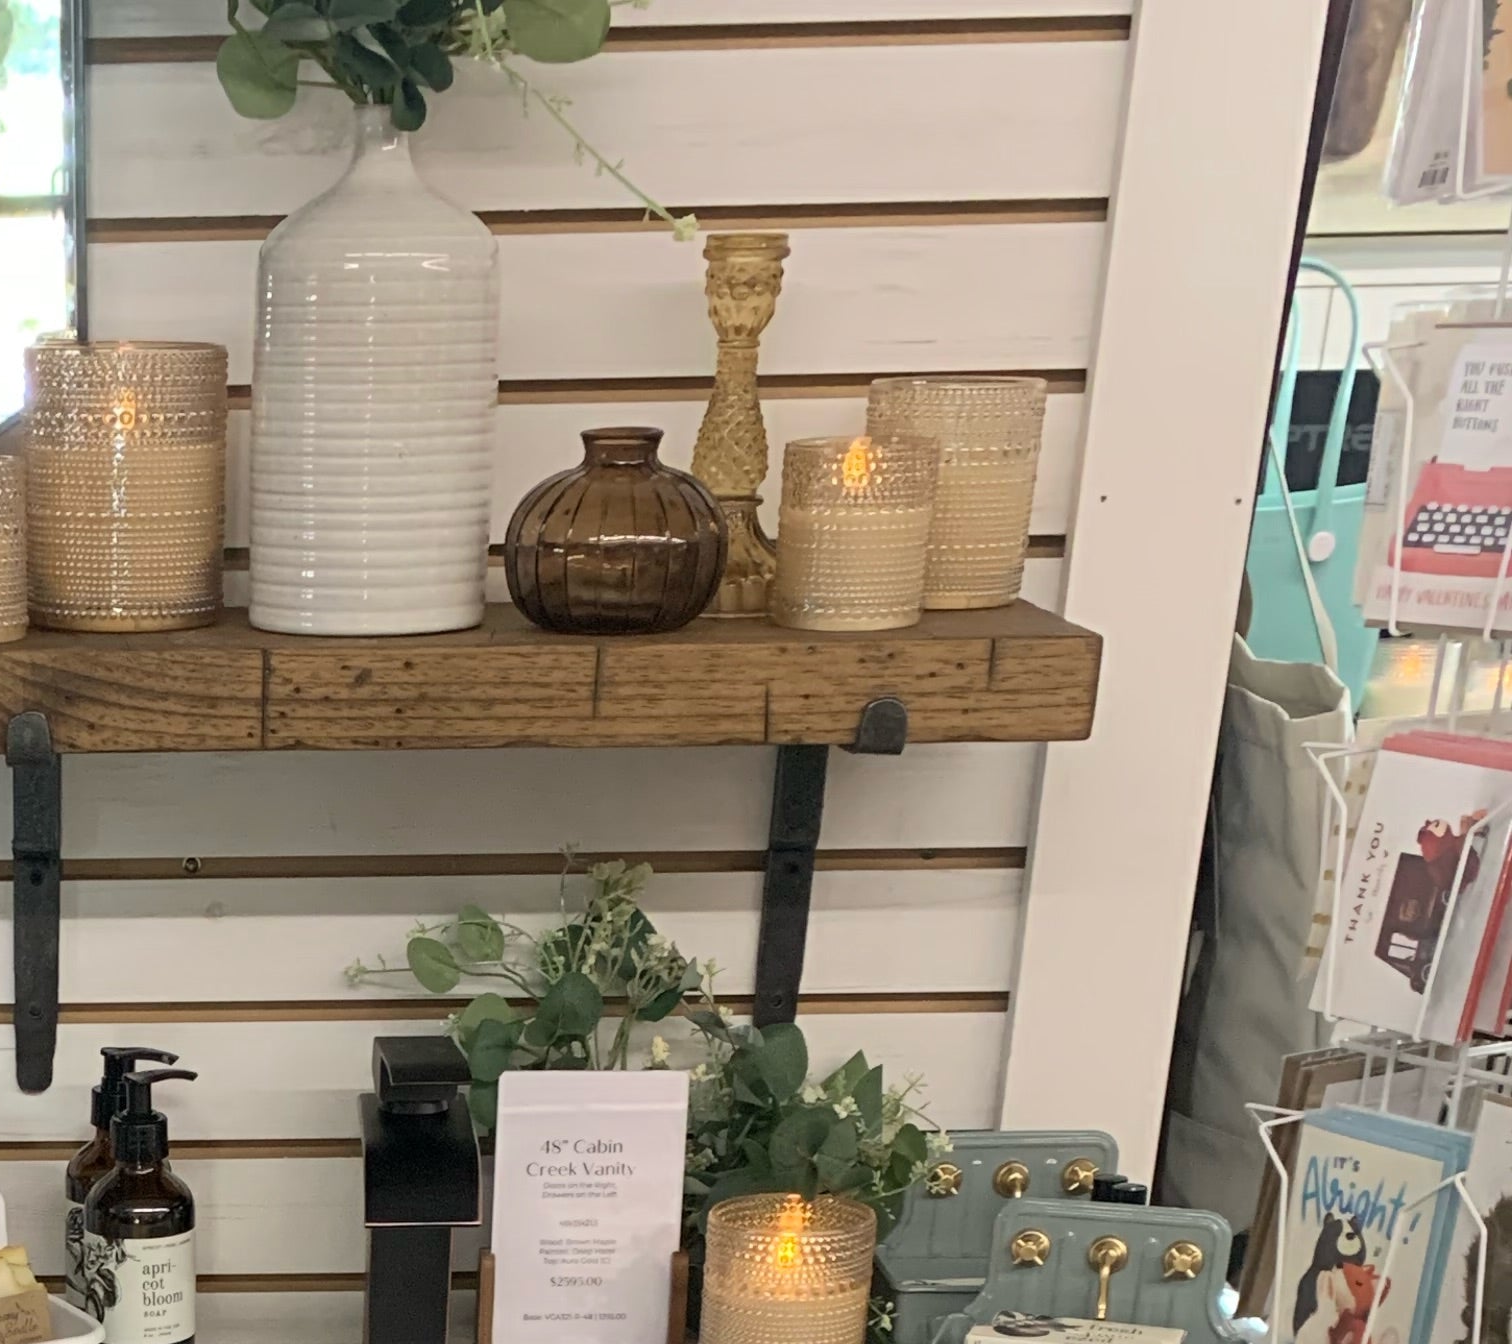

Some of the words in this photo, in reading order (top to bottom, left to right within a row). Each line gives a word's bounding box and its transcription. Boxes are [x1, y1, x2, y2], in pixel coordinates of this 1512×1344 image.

[1366, 822, 1385, 861] YOU
[1345, 873, 1370, 944] THANK
[573, 1139, 623, 1154] Cabin
[526, 1162, 577, 1177] Creek
[583, 1161, 636, 1178] Vanity
[142, 1258, 177, 1276] apri-
[142, 1278, 165, 1291] cot
[143, 1290, 184, 1307] bloom
